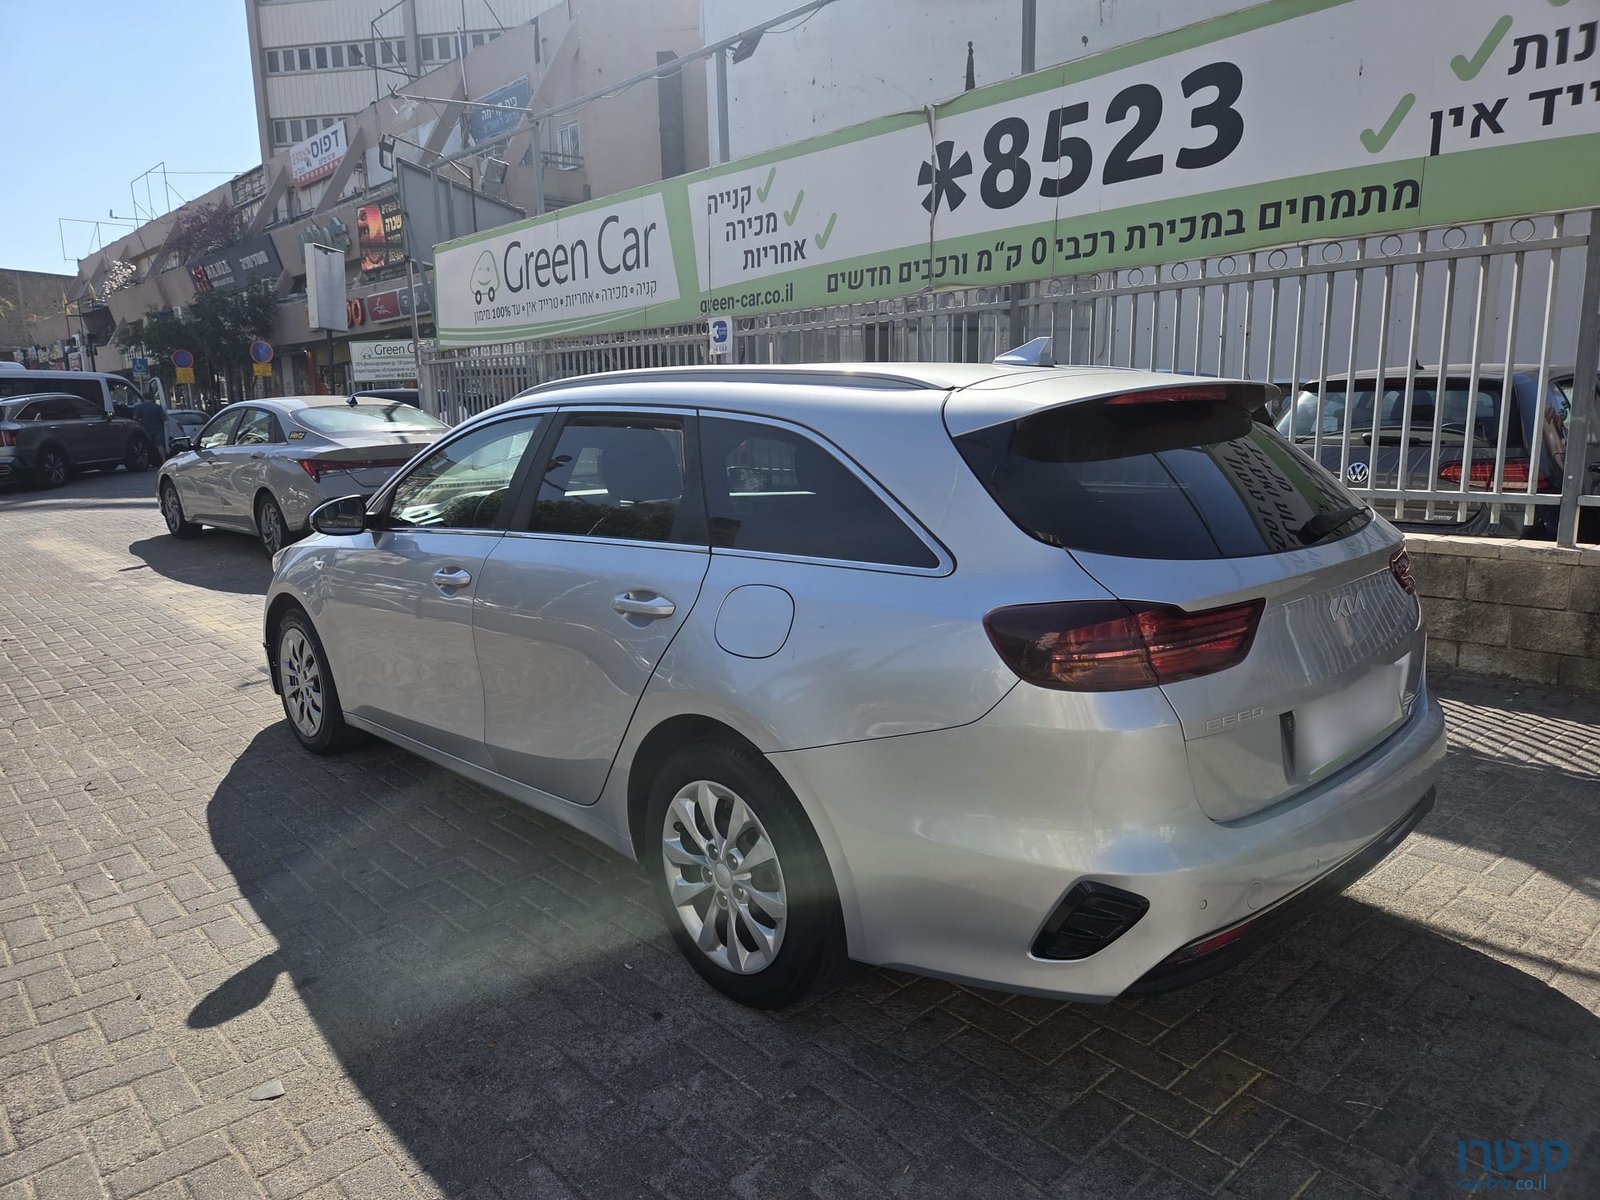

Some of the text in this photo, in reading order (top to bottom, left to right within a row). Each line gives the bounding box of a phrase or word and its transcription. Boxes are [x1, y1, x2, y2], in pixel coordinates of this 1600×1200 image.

[1429, 97, 1509, 157] אין
[310, 129, 339, 159] דפוס
[707, 185, 752, 215] קנייה
[1258, 179, 1420, 231] מתמחים
[725, 212, 778, 242] מכירה
[1124, 208, 1246, 252] במכירת
[503, 215, 657, 293] Green Car
[742, 238, 807, 270] אחריות
[1031, 236, 1048, 265] 0
[1055, 230, 1116, 260] רכבי
[826, 265, 892, 293] חדשים
[898, 253, 969, 283] ורכבים
[474, 280, 657, 325] קניה מכירה אחריות טרייד אין עד 100% מימון
[374, 343, 405, 356] Green
